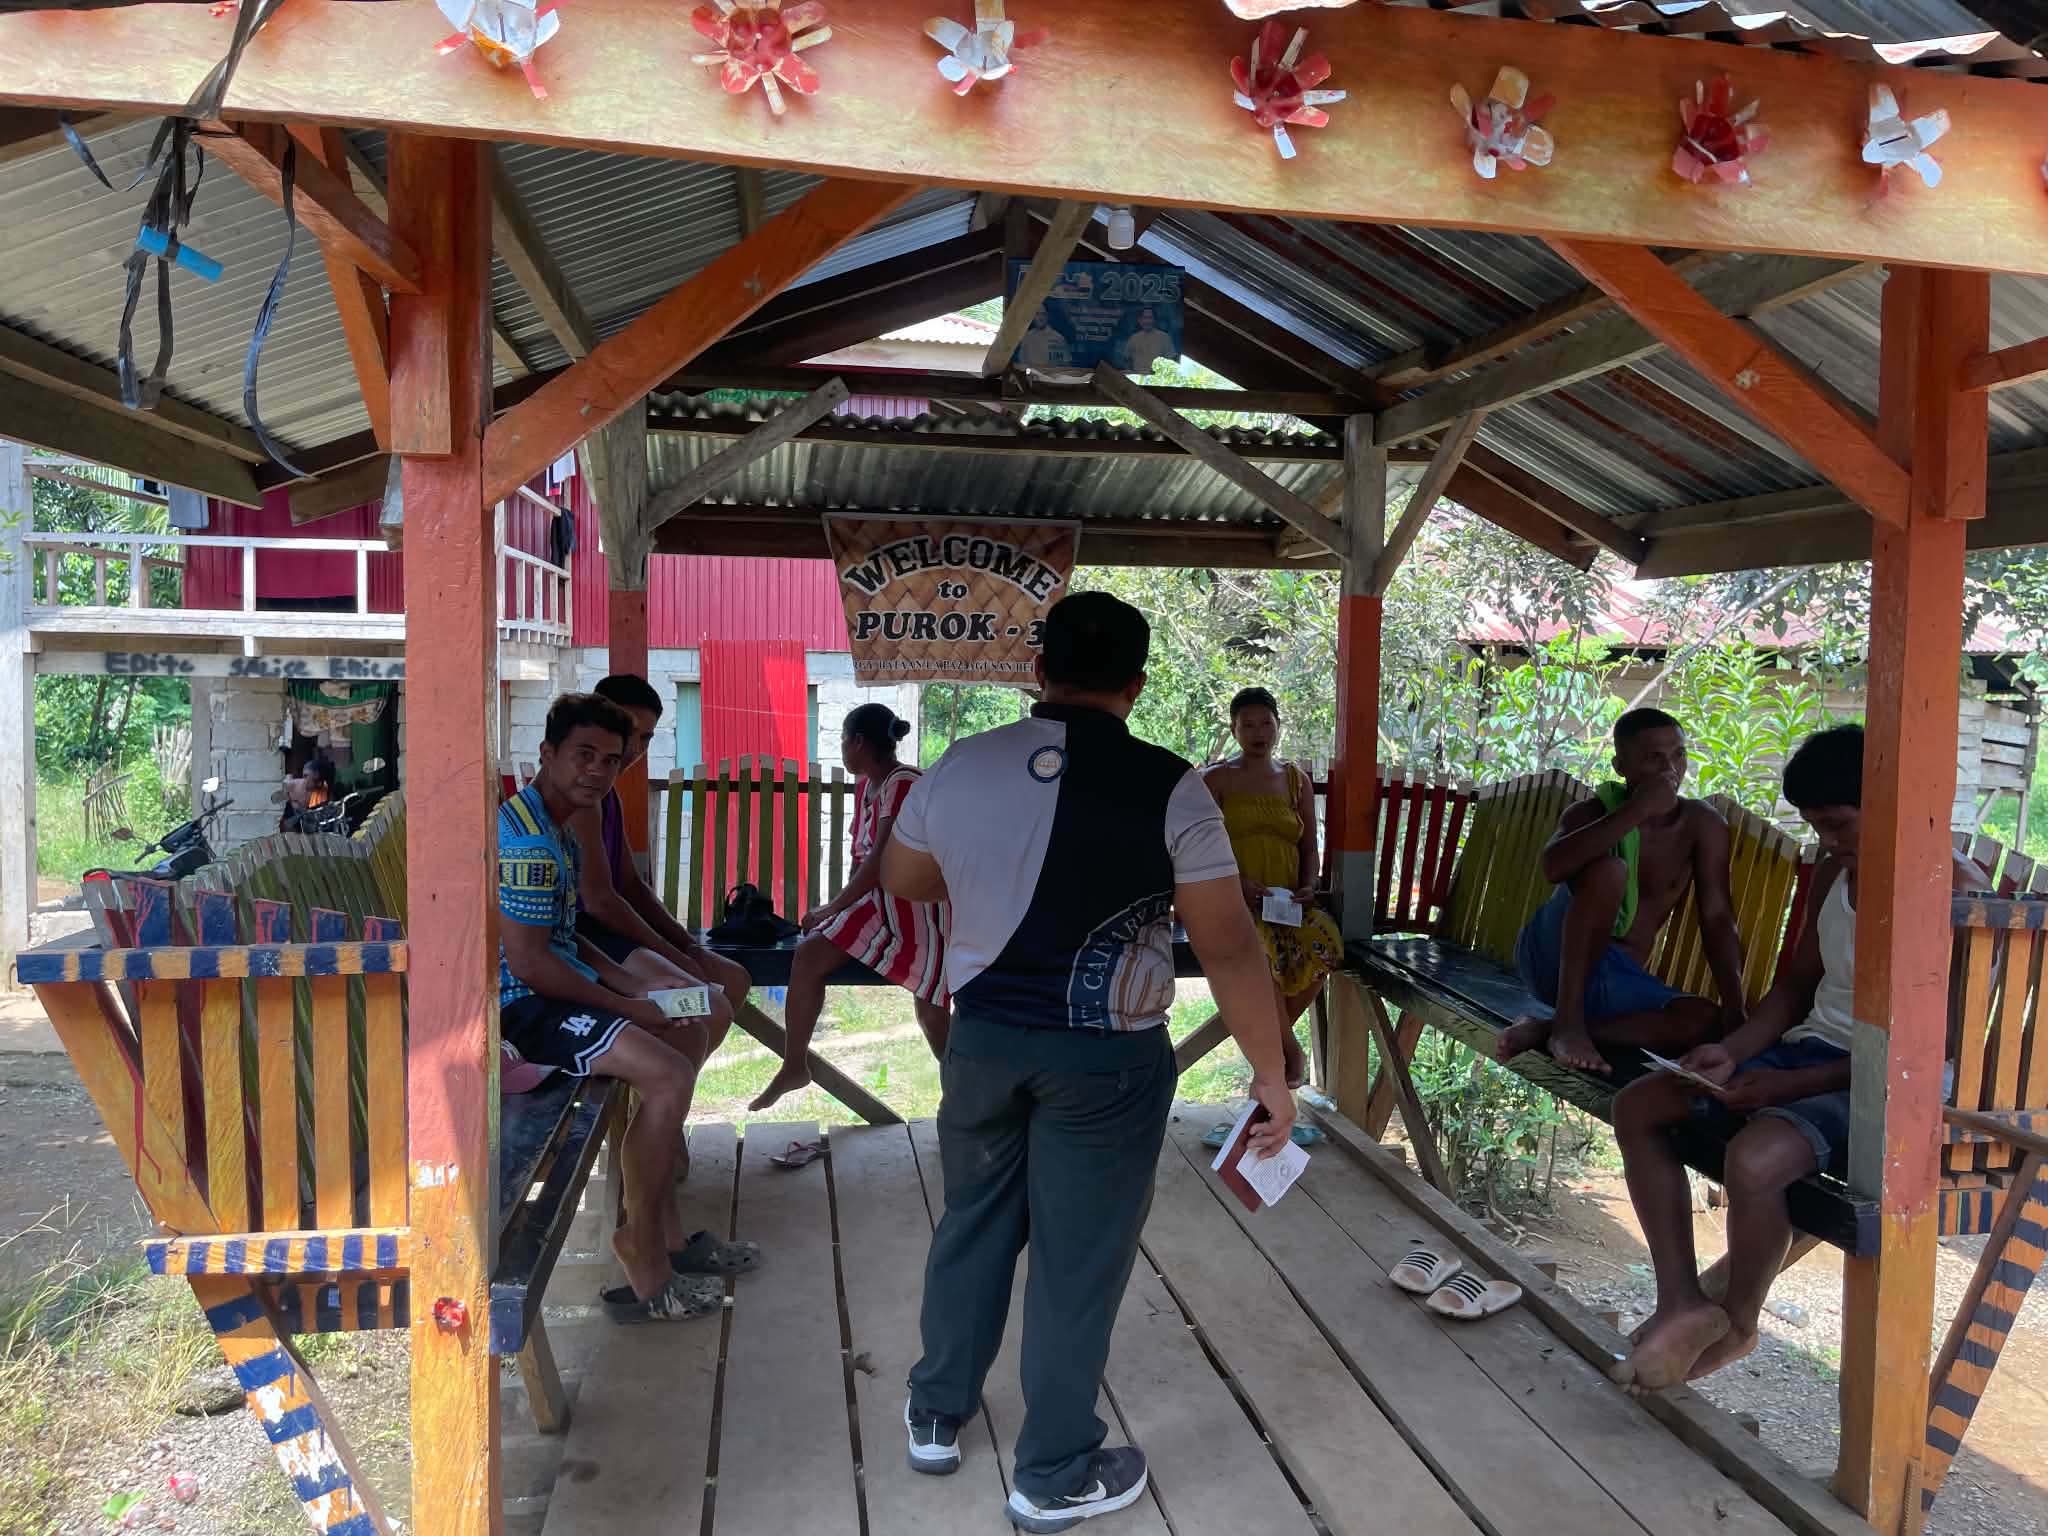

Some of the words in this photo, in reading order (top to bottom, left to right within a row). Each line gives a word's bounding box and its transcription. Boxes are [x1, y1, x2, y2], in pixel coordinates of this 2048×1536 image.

[1103, 271, 1182, 304] 2025
[843, 536, 1063, 604] WELCOME
[937, 580, 968, 600] to
[855, 612, 997, 641] PUROK
[559, 1013, 598, 1037] LA
